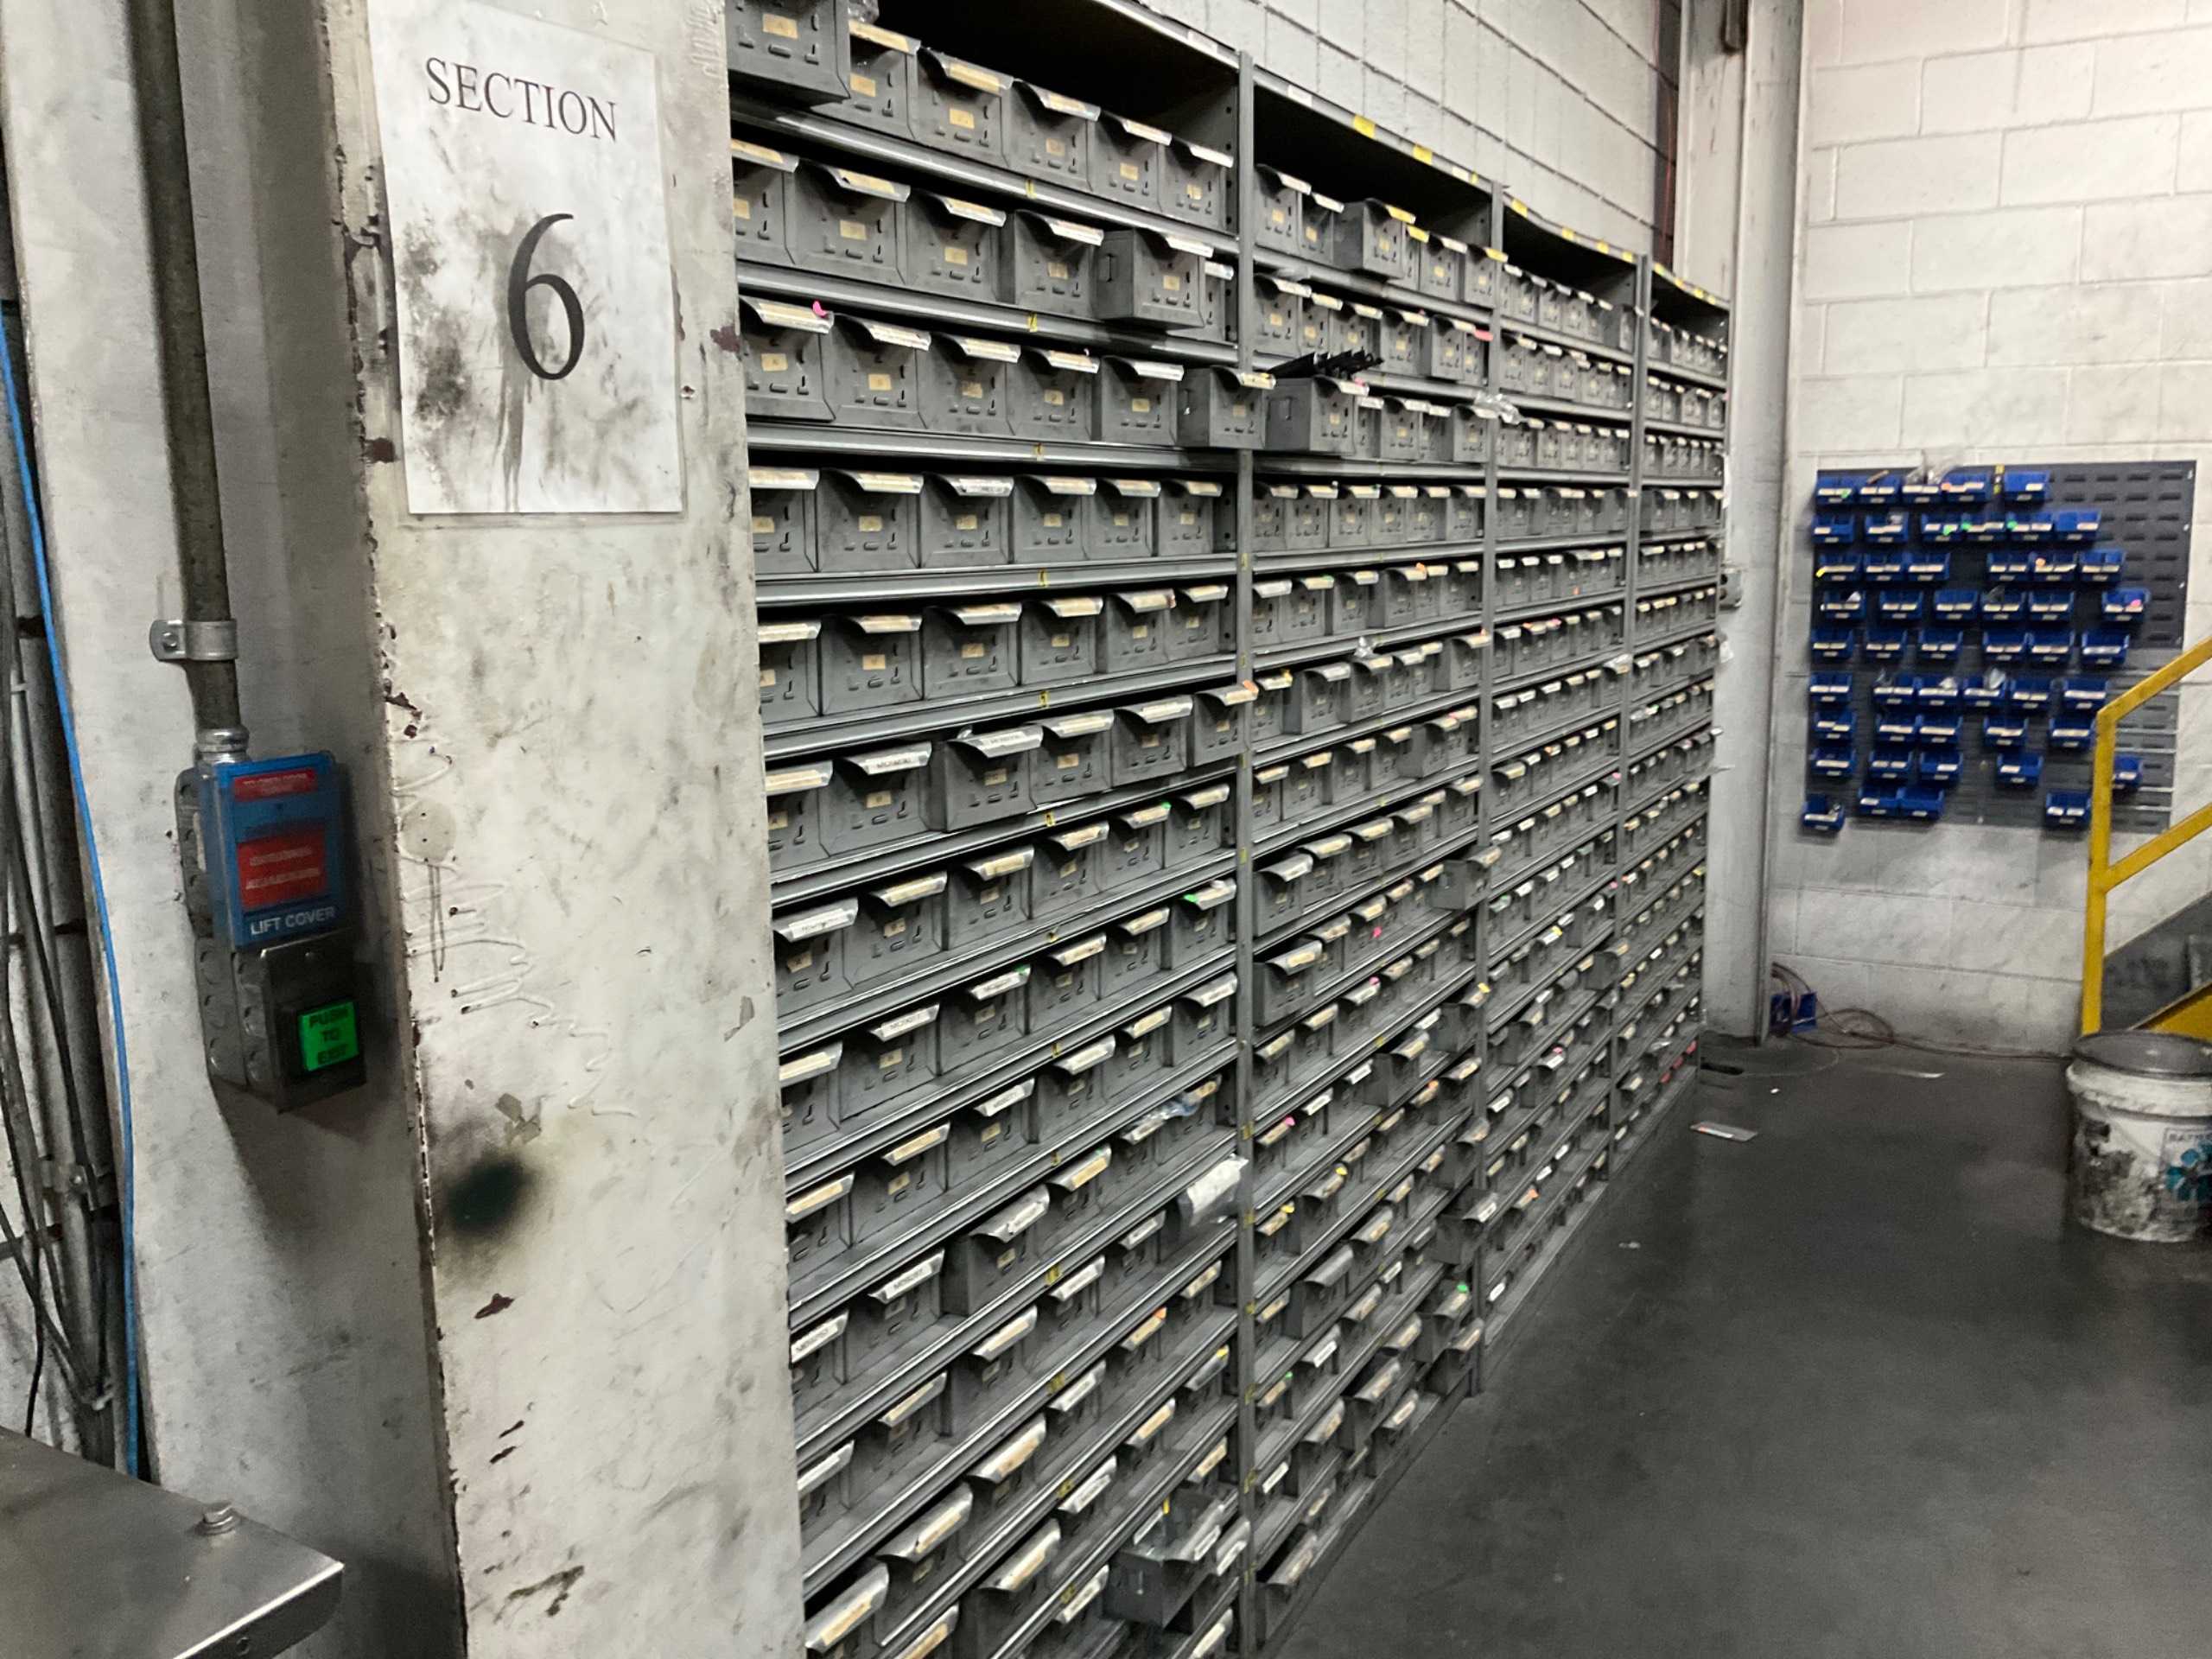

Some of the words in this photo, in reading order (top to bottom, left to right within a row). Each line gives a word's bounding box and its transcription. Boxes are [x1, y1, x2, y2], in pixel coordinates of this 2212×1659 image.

[426, 57, 616, 143] SECTION
[508, 213, 584, 381] 6
[251, 917, 281, 934] LIFT
[285, 906, 335, 927] COVER
